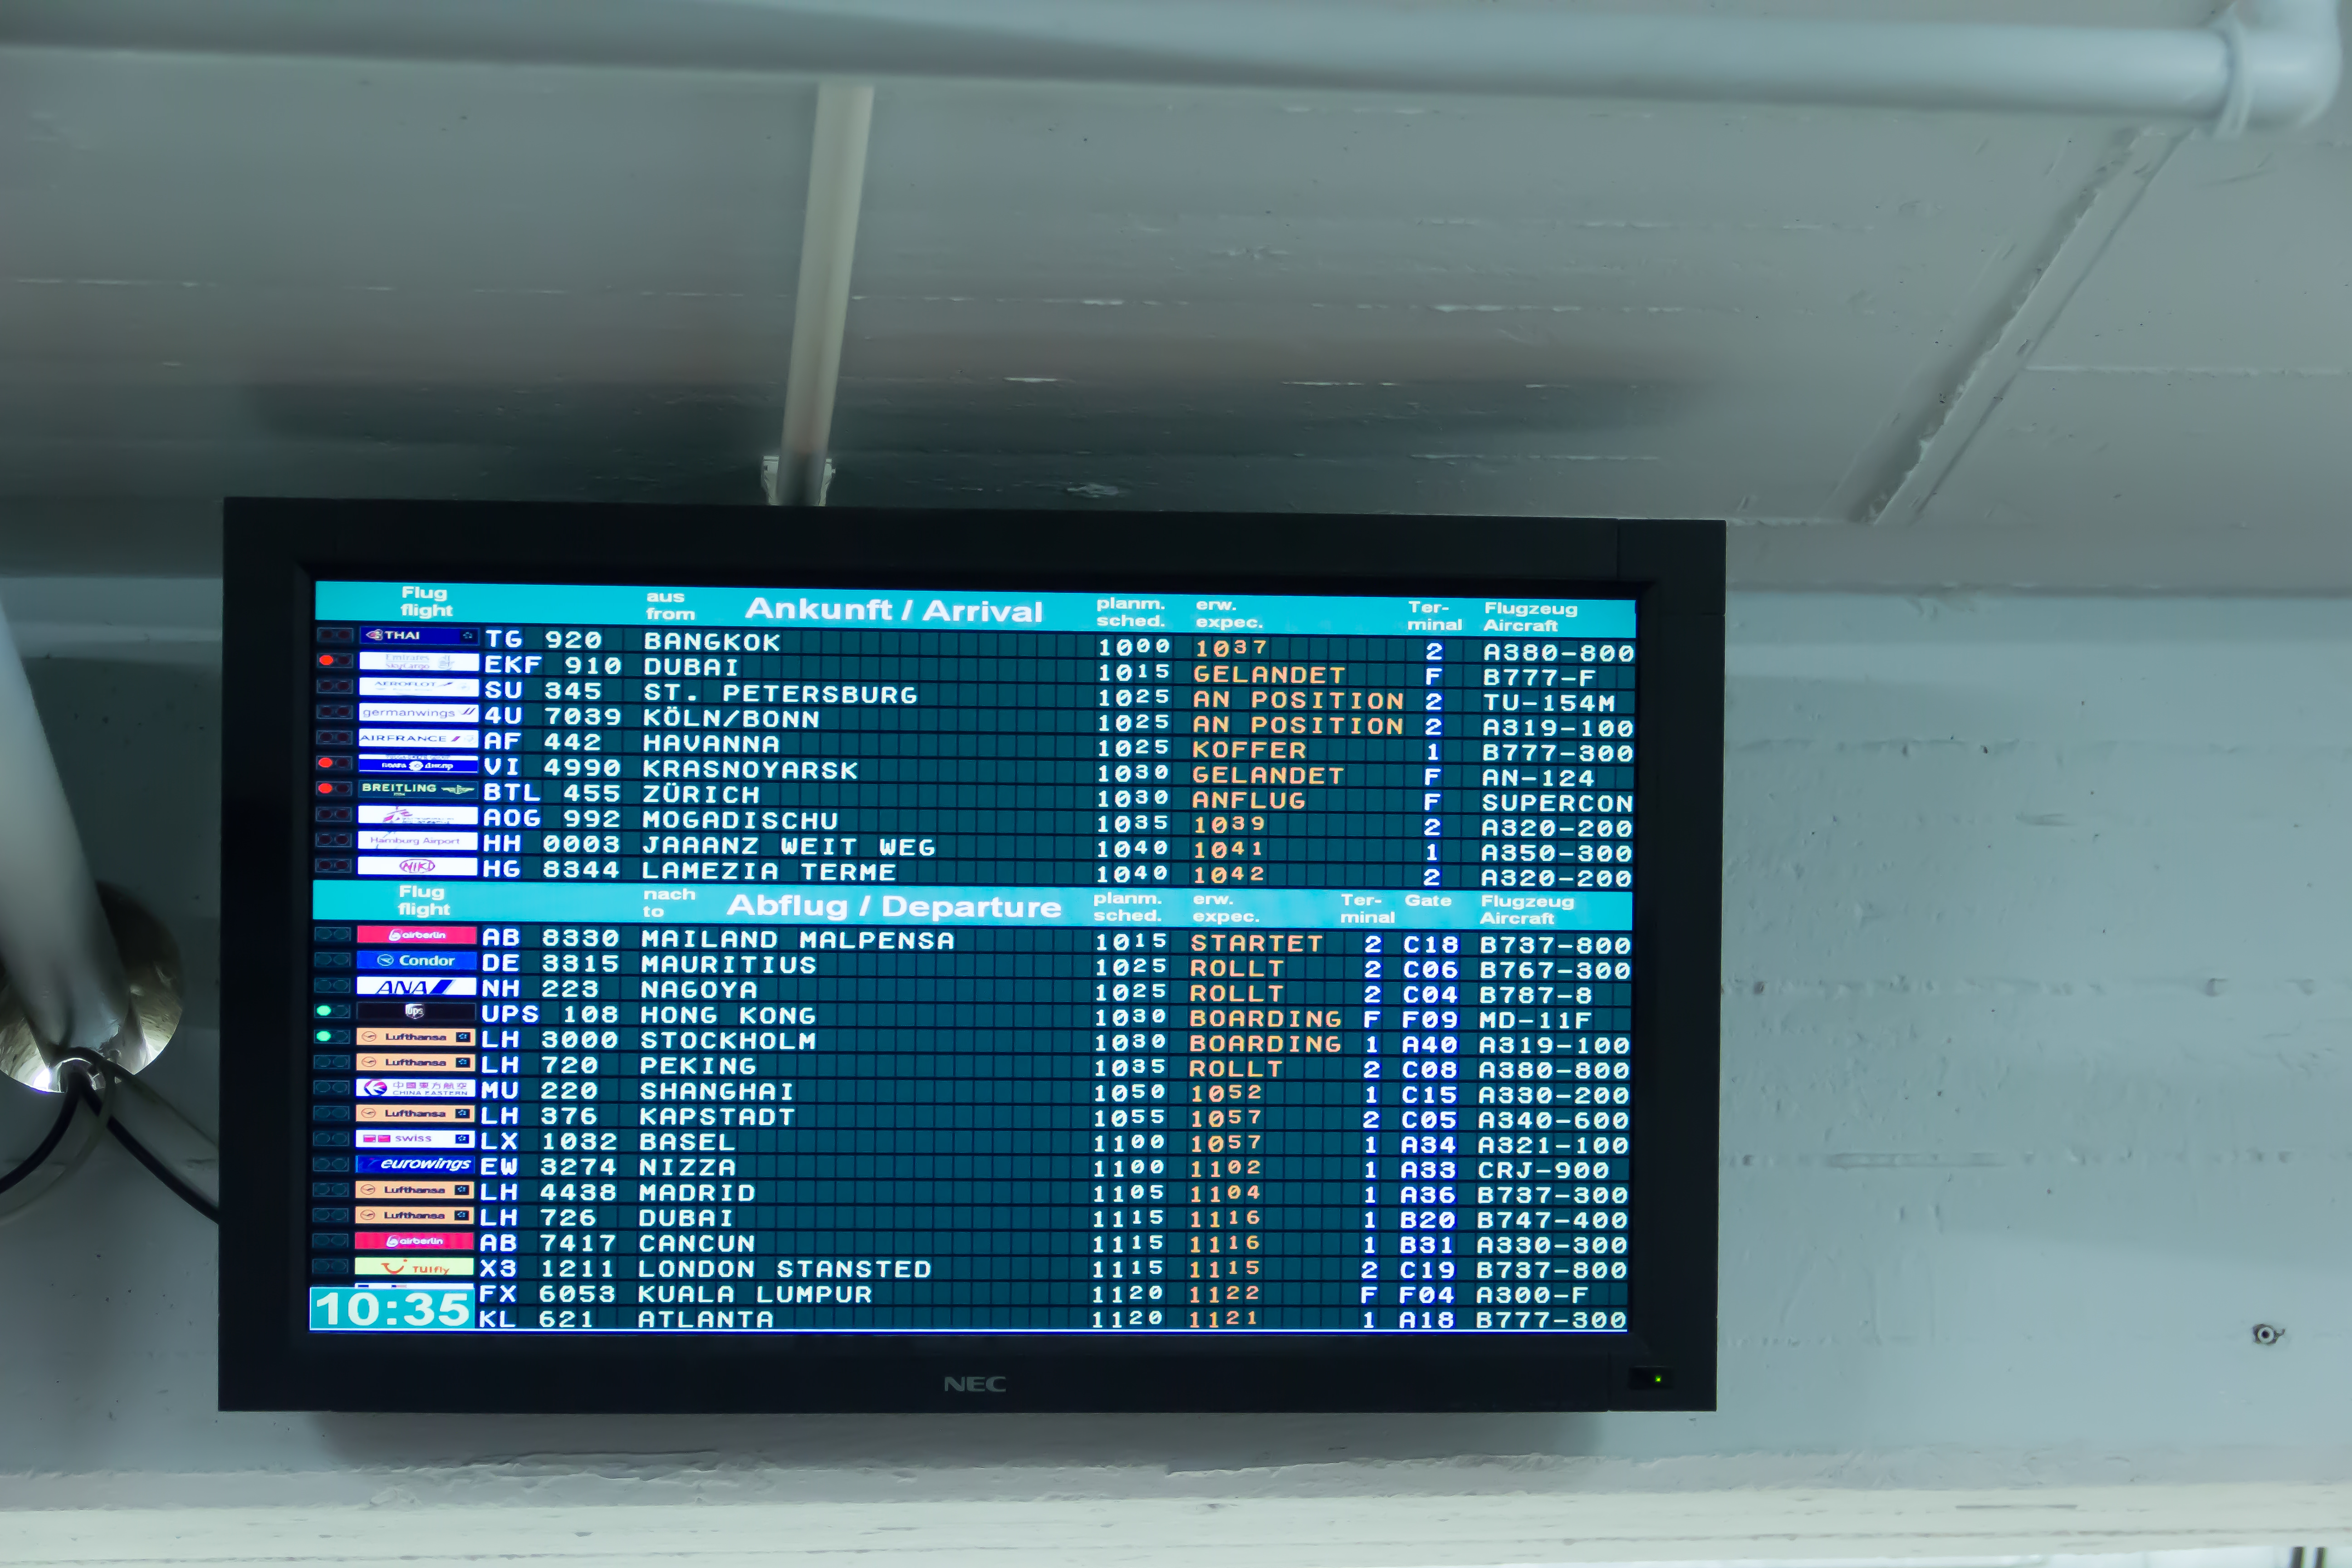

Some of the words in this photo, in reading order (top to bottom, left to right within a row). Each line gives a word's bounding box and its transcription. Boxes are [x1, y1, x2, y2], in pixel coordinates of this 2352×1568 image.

[402, 586, 447, 602] Flug
[647, 593, 685, 603] aus
[401, 603, 453, 619] flight
[646, 607, 695, 620] from
[745, 597, 892, 620] Ankunft
[901, 599, 913, 621] /
[922, 600, 1042, 622] Arrival
[1097, 597, 1165, 612] planm.
[1196, 601, 1236, 611] erw.
[1408, 601, 1449, 613] Ter-
[1485, 602, 1578, 618] Flugzeug
[1097, 614, 1165, 627] sched.
[1196, 618, 1263, 632] expec.
[1407, 618, 1462, 631] minal
[1483, 619, 1558, 632] Aircraft
[384, 631, 420, 640] THAI
[485, 629, 522, 648] TG
[544, 630, 602, 649] 920
[644, 632, 780, 652] BANGKOK
[1099, 638, 1170, 657] 1000
[1196, 639, 1267, 658] 1037
[1426, 642, 1443, 661] 2
[1484, 643, 1634, 662] A380-800
[485, 681, 522, 699] SU
[544, 681, 601, 700] 345
[644, 683, 696, 701] ST.
[723, 684, 917, 704] PETERSBURG
[1099, 689, 1169, 707] 1025
[1193, 690, 1230, 708] AN
[1251, 691, 1404, 710] POSITION
[1425, 692, 1443, 711] 2
[1483, 693, 1615, 712] TU-154M
[363, 709, 456, 718] germanwings
[484, 731, 522, 750] AF
[544, 732, 601, 751] 442
[643, 734, 779, 754] HAVANNA
[1098, 739, 1169, 757] 1025
[1192, 740, 1307, 760] KOFFER
[1427, 743, 1439, 761] 1
[1482, 743, 1633, 762] B777-300
[362, 783, 437, 792] BREITLING
[483, 782, 541, 802] BTL
[563, 784, 620, 803] 455
[642, 782, 759, 804] ZÜRICH
[1098, 789, 1168, 808] 1030
[1192, 790, 1305, 810] ANFLUG
[1424, 793, 1441, 811] F
[1482, 793, 1632, 813] SUPERCON
[371, 837, 420, 845] Hamburg
[483, 834, 521, 853] HH
[543, 834, 620, 853] 0003
[642, 836, 759, 855] JAAANZ
[780, 837, 857, 856] WEIT
[879, 838, 935, 857] WEG
[1097, 840, 1167, 858] 1040
[1194, 841, 1262, 859] 1041
[1481, 843, 1632, 862] A350-300
[399, 885, 445, 901] Flug
[644, 888, 696, 900] nach
[1093, 892, 1162, 906] planm.
[1193, 895, 1234, 905] erw.
[1341, 893, 1382, 906] Ter-
[1404, 894, 1452, 906] Gate
[1481, 894, 1574, 911] Flugzeug
[397, 902, 451, 918] flight
[643, 906, 664, 917] to
[726, 894, 848, 920] Abflug
[859, 895, 871, 916] /
[882, 895, 1062, 922] Departure
[1093, 909, 1162, 922] sched.
[1340, 911, 1395, 924] minal
[1192, 912, 1259, 925] expec.
[1480, 912, 1555, 925] Aircraft
[482, 927, 520, 947] AB
[542, 928, 619, 947] 8330
[641, 929, 777, 949] MAILAND
[799, 931, 954, 950] MALPENSA
[1096, 932, 1166, 951] 1015
[1191, 934, 1323, 953] STARTET
[1364, 935, 1382, 953] 2
[1403, 935, 1459, 954] C18
[1480, 936, 1631, 955] B737-800
[399, 955, 456, 966] Condor
[375, 980, 427, 995] ANA
[481, 979, 520, 998] NH
[541, 980, 598, 998] 223
[641, 980, 757, 999] NAGOYA
[1096, 983, 1166, 1002] 1025
[1190, 984, 1284, 1003] ROLLT
[1364, 985, 1382, 1004] 2
[1403, 985, 1458, 1004] C04
[1479, 986, 1592, 1004] B787-8
[386, 1033, 446, 1041] Lufthansa
[481, 1030, 519, 1049] LH
[541, 1030, 618, 1049] 3000
[640, 1031, 816, 1050] STOCKHOLM
[1095, 1033, 1166, 1052] 1030
[1189, 1034, 1341, 1054] BOARDING
[1366, 1035, 1378, 1054] 1
[1402, 1035, 1458, 1054] A40
[1479, 1036, 1630, 1054] A319-100
[481, 1081, 519, 1100] MU
[540, 1081, 598, 1100] 220
[640, 1082, 793, 1101] SHANGHAI
[1094, 1083, 1165, 1102] 1050
[1192, 1084, 1262, 1103] 1052
[1366, 1085, 1377, 1104] 1
[1401, 1085, 1457, 1104] C15
[1478, 1086, 1629, 1104] A330-200
[395, 1134, 432, 1142] swiss
[480, 1132, 518, 1151] LX
[543, 1132, 617, 1151] 1032
[639, 1132, 735, 1151] BASEL
[1094, 1134, 1165, 1152] 1100
[1191, 1134, 1261, 1153] 1057
[1401, 1136, 1456, 1154] A34
[1478, 1136, 1628, 1154] A321-100
[381, 1158, 472, 1171] eurowings
[480, 1183, 518, 1201] LH
[539, 1183, 616, 1201] 4438
[639, 1183, 755, 1202] MADRID
[1093, 1184, 1164, 1203] 1105
[1191, 1185, 1260, 1203] 1104
[1400, 1186, 1456, 1204] A36
[1477, 1186, 1628, 1204] B737-300
[480, 1233, 517, 1252] AB
[539, 1234, 616, 1252] 7417
[639, 1234, 755, 1253] CANCUN
[1093, 1235, 1163, 1254] 1115
[1190, 1235, 1260, 1254] 1116
[1399, 1235, 1452, 1254] B31
[1476, 1236, 1627, 1254] A330-300
[479, 1284, 517, 1303] FX
[539, 1285, 615, 1303] 6053
[638, 1285, 734, 1303] KUALA
[756, 1285, 872, 1303] LUMPUR
[1093, 1285, 1163, 1303] 1120
[1190, 1285, 1259, 1303] 1122
[1360, 1286, 1378, 1304] F
[1399, 1286, 1455, 1304] F04
[1476, 1286, 1588, 1304] A300-F
[315, 1293, 470, 1326] 10:35
[945, 1377, 1006, 1392] NEC
